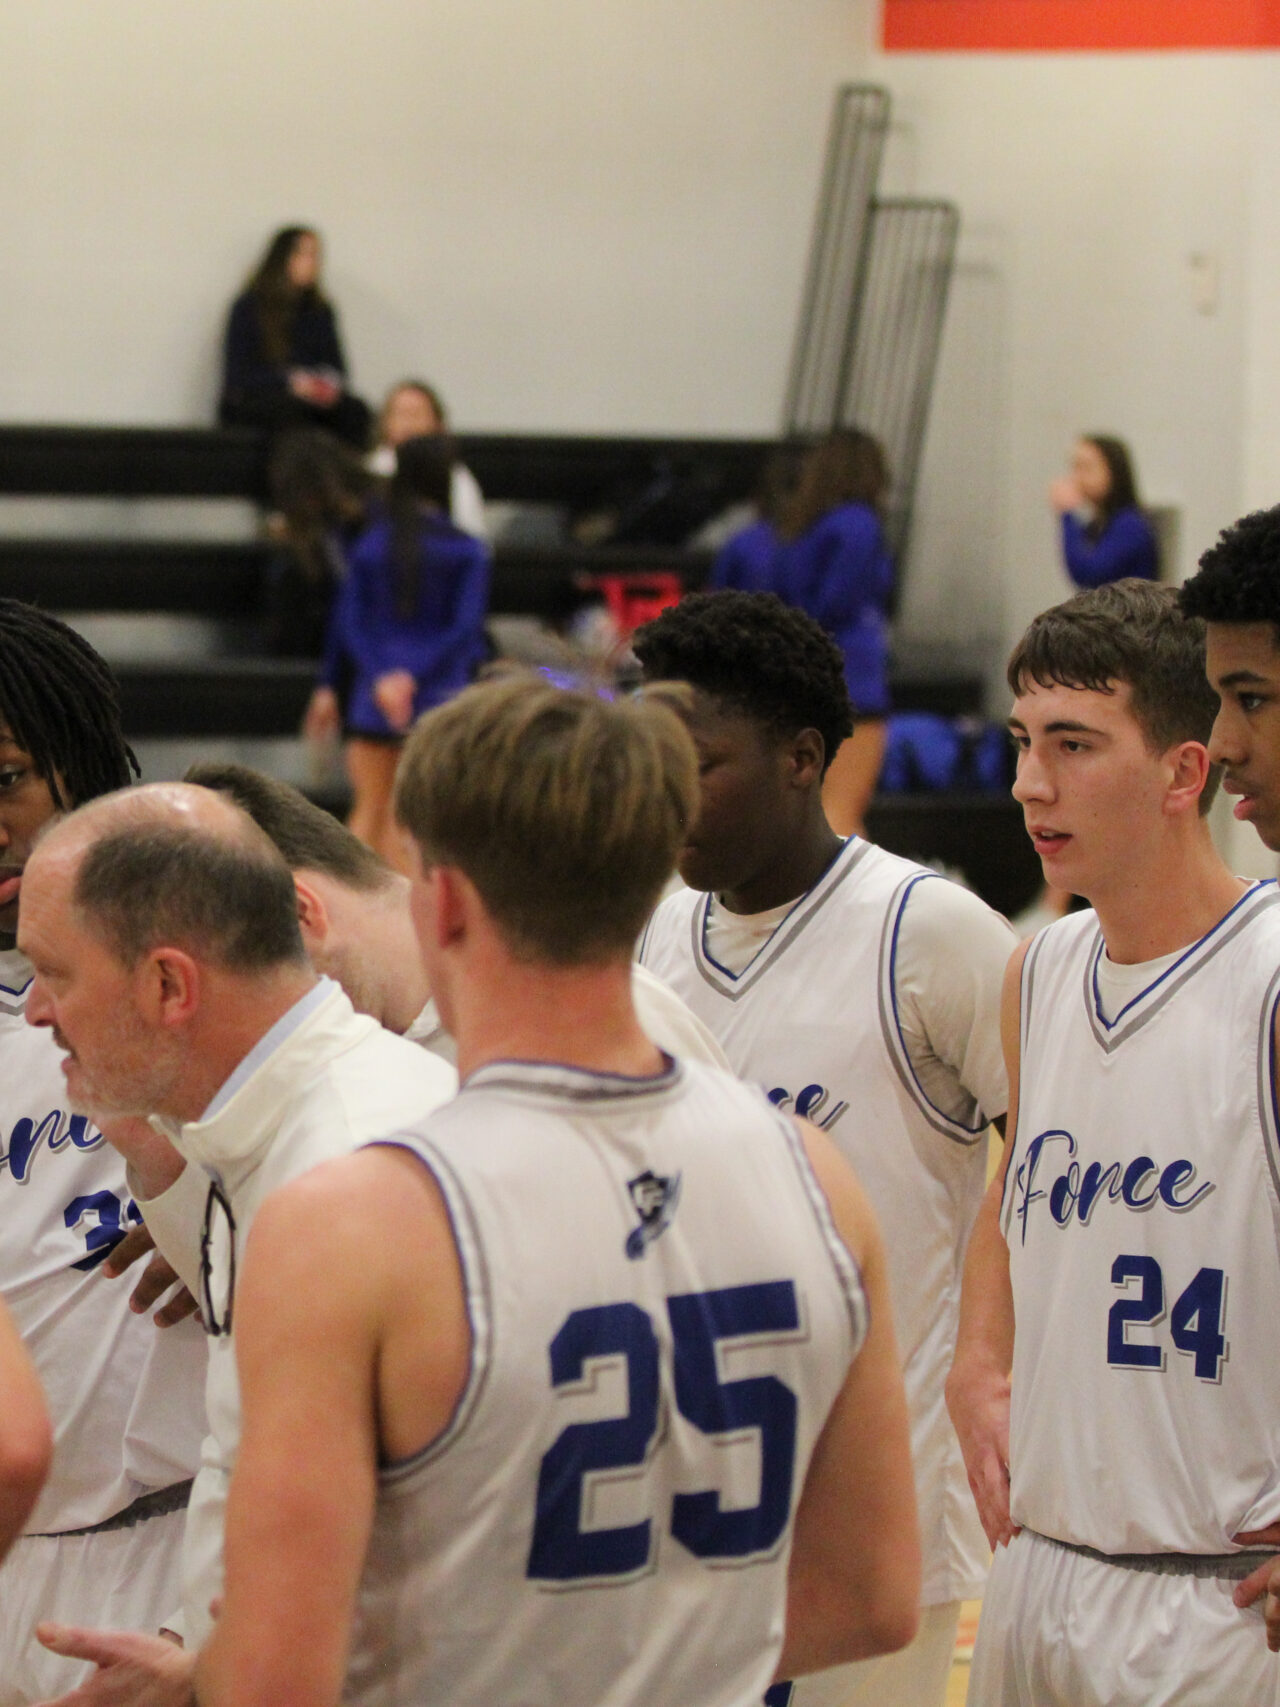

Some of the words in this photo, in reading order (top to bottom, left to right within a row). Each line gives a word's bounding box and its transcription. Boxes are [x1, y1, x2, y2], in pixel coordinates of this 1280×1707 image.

[63, 1189, 145, 1272] 3
[1017, 1129, 1215, 1247] Force
[1106, 1254, 1229, 1384] 24
[526, 1279, 808, 1590] 25
